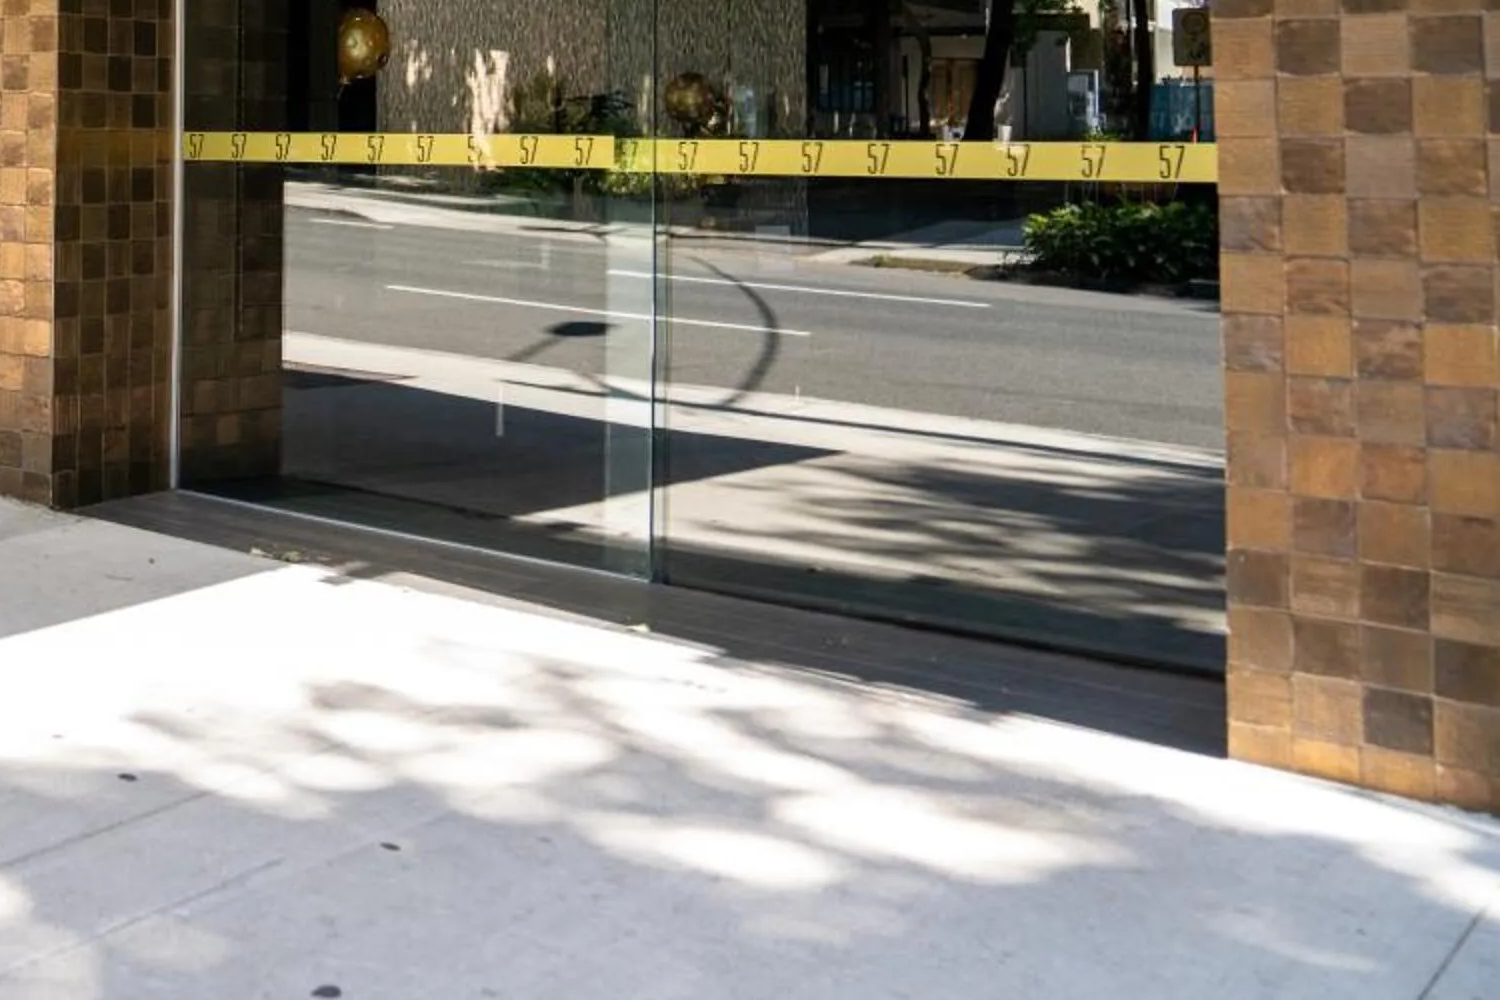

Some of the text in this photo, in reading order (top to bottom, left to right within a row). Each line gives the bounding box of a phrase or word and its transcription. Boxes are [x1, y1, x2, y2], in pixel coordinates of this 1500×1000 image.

[189, 134, 204, 159] 57
[231, 134, 247, 159] 57
[275, 134, 291, 160] 57
[321, 135, 337, 160] 57
[367, 135, 385, 161] 57
[416, 136, 434, 162] 57
[520, 136, 539, 164] 57
[575, 137, 594, 165] 57
[678, 142, 1185, 178] 57 57 57 57 57 57 57 57
